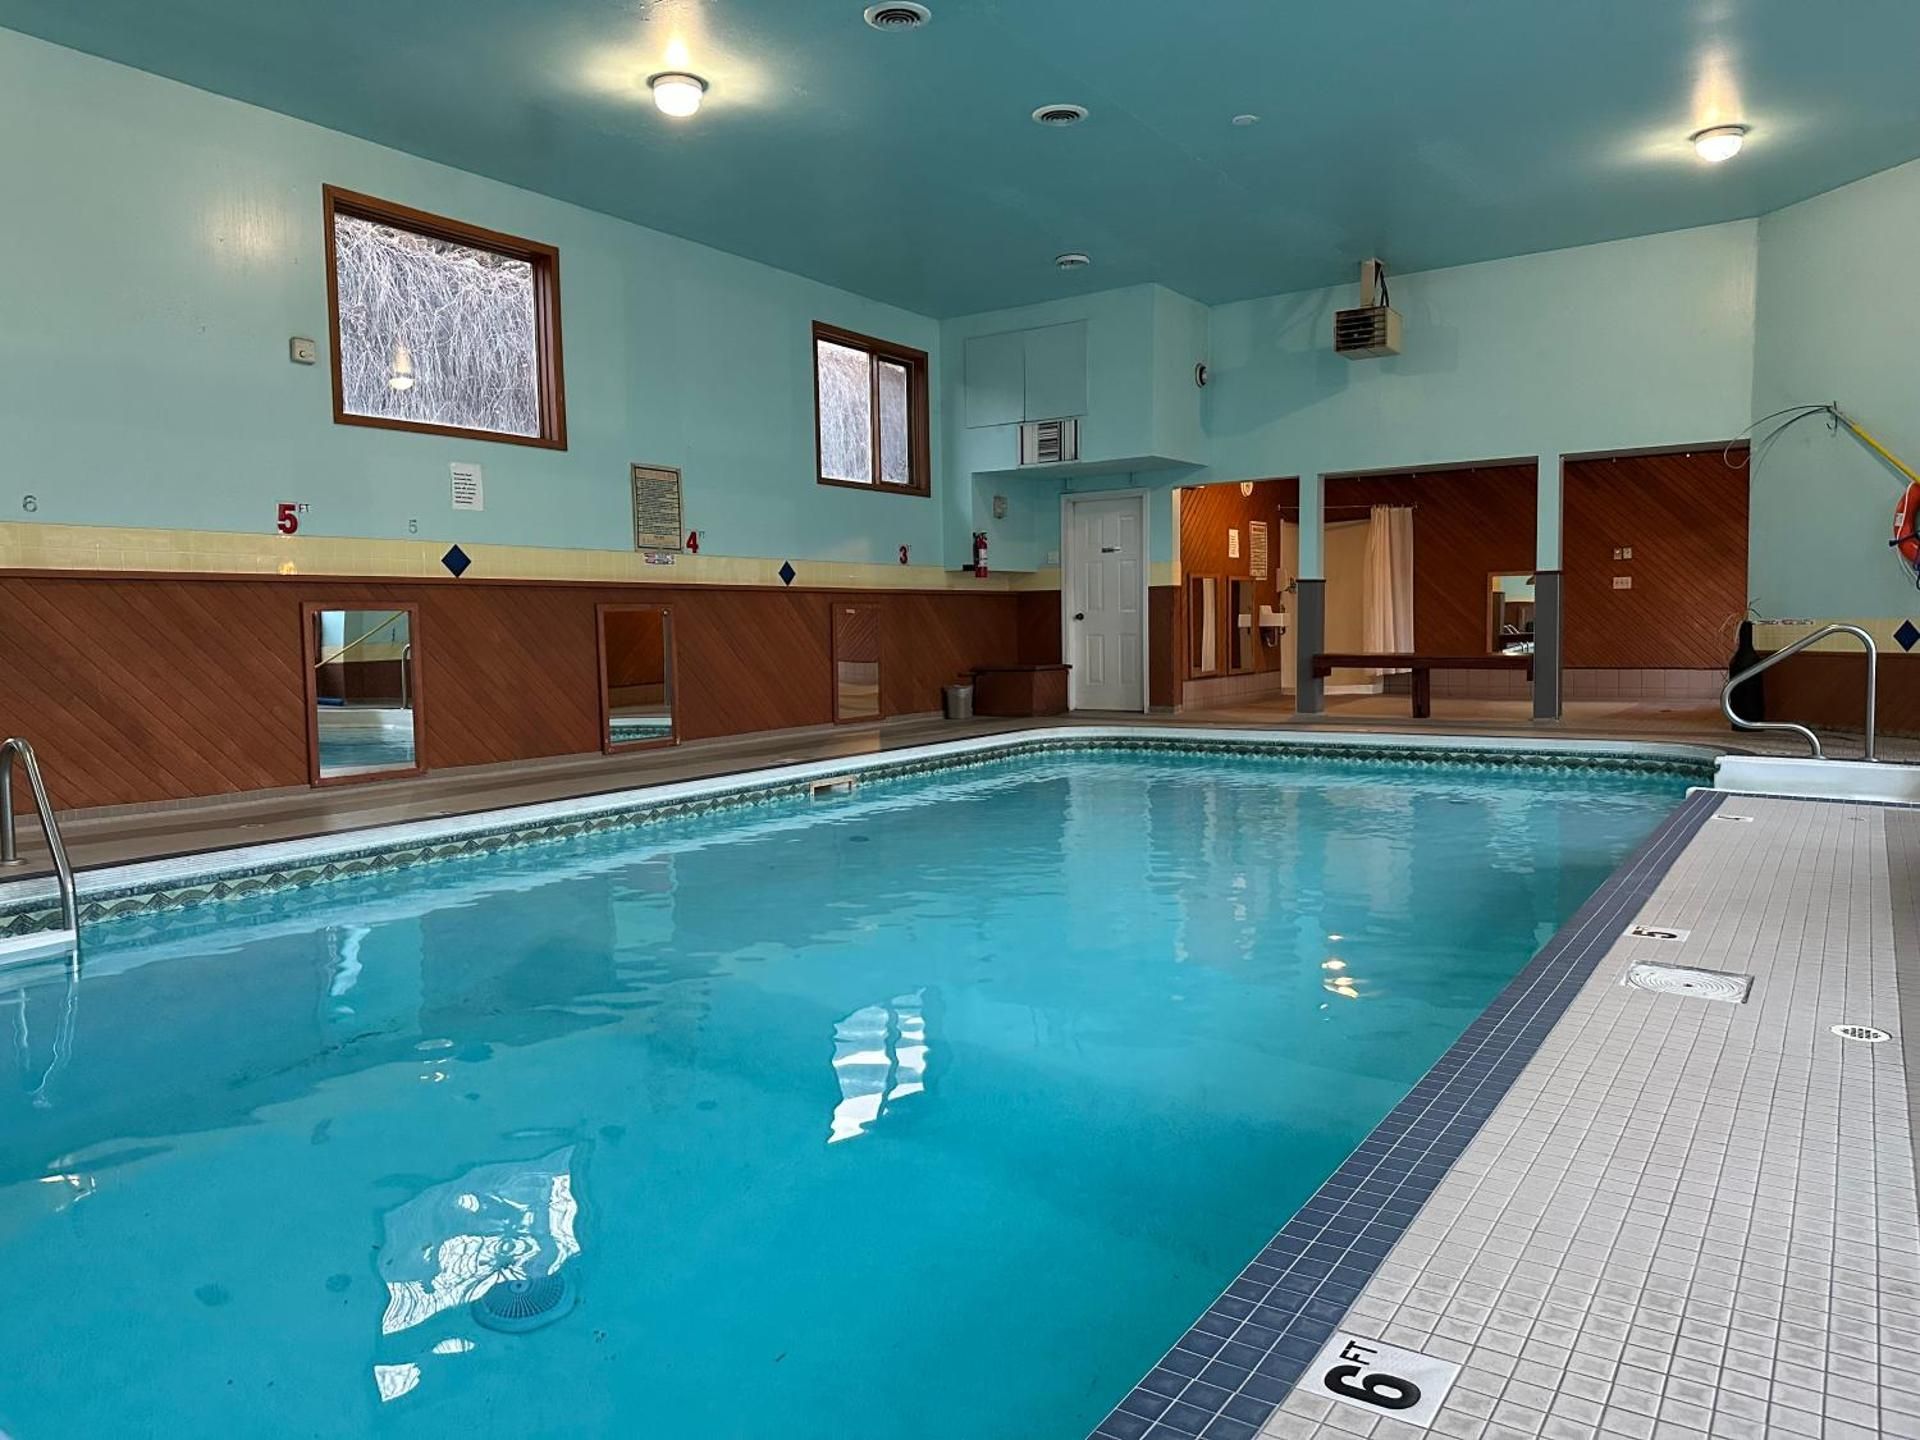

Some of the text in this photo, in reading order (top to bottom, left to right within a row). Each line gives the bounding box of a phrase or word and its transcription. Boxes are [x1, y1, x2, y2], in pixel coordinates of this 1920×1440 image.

[23, 495, 37, 512] 6
[278, 503, 310, 534] 5 FT
[409, 519, 417, 534] 5
[686, 531, 699, 554] 4
[899, 545, 908, 564] 3
[1324, 1340, 1421, 1410] 6 FT
